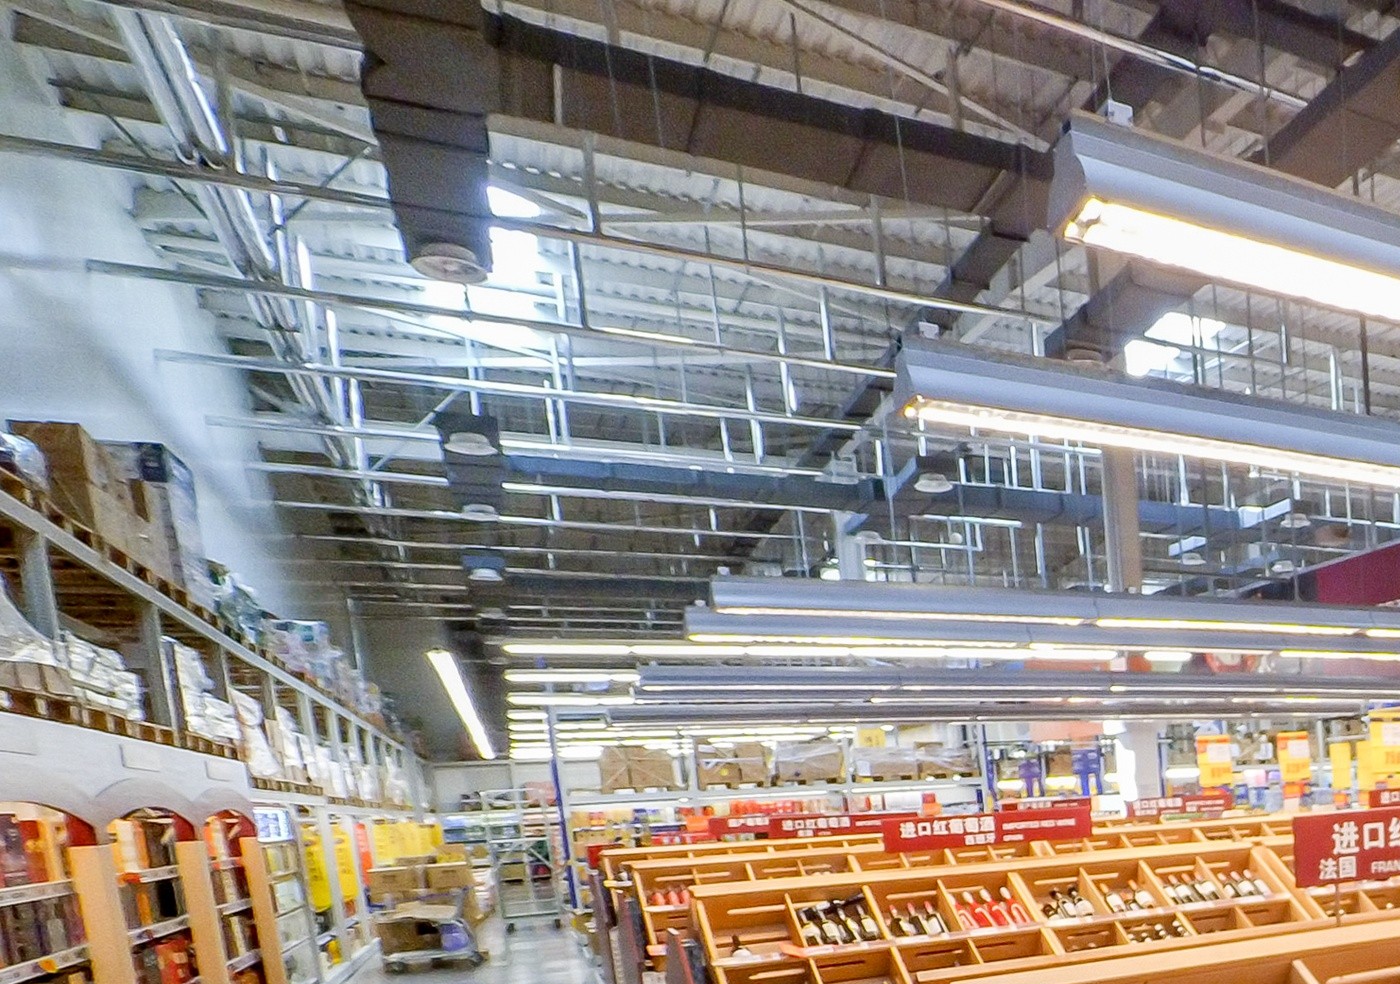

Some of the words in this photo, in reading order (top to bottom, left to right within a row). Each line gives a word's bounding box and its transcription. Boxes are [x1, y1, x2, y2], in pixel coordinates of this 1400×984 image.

[900, 815, 995, 839] 进口红葡萄酒
[1319, 855, 1358, 880] 法国
